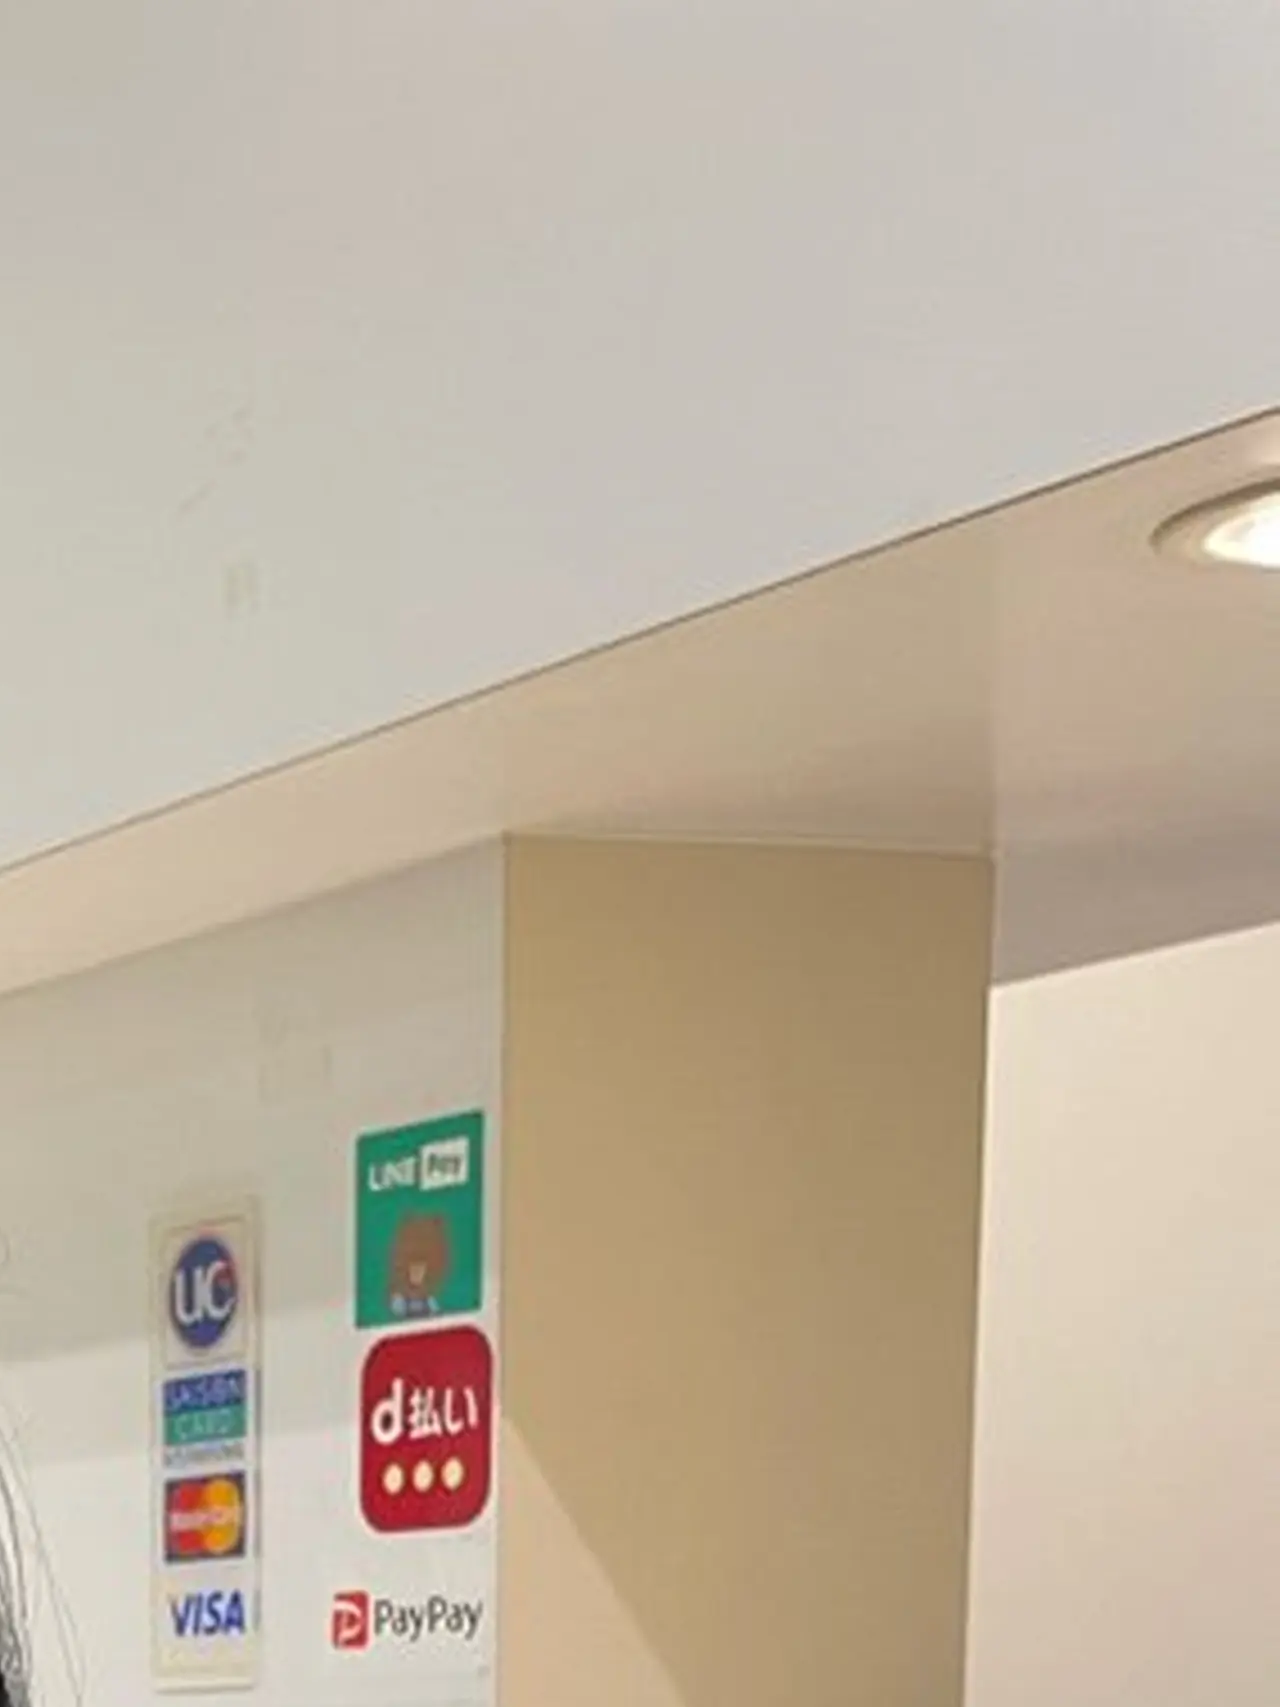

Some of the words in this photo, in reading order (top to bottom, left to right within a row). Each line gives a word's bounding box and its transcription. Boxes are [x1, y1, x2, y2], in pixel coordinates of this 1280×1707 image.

[175, 1258, 236, 1326] UC
[371, 1378, 478, 1444] d払い
[170, 1590, 246, 1637] VISA
[374, 1594, 483, 1643] PayPay
